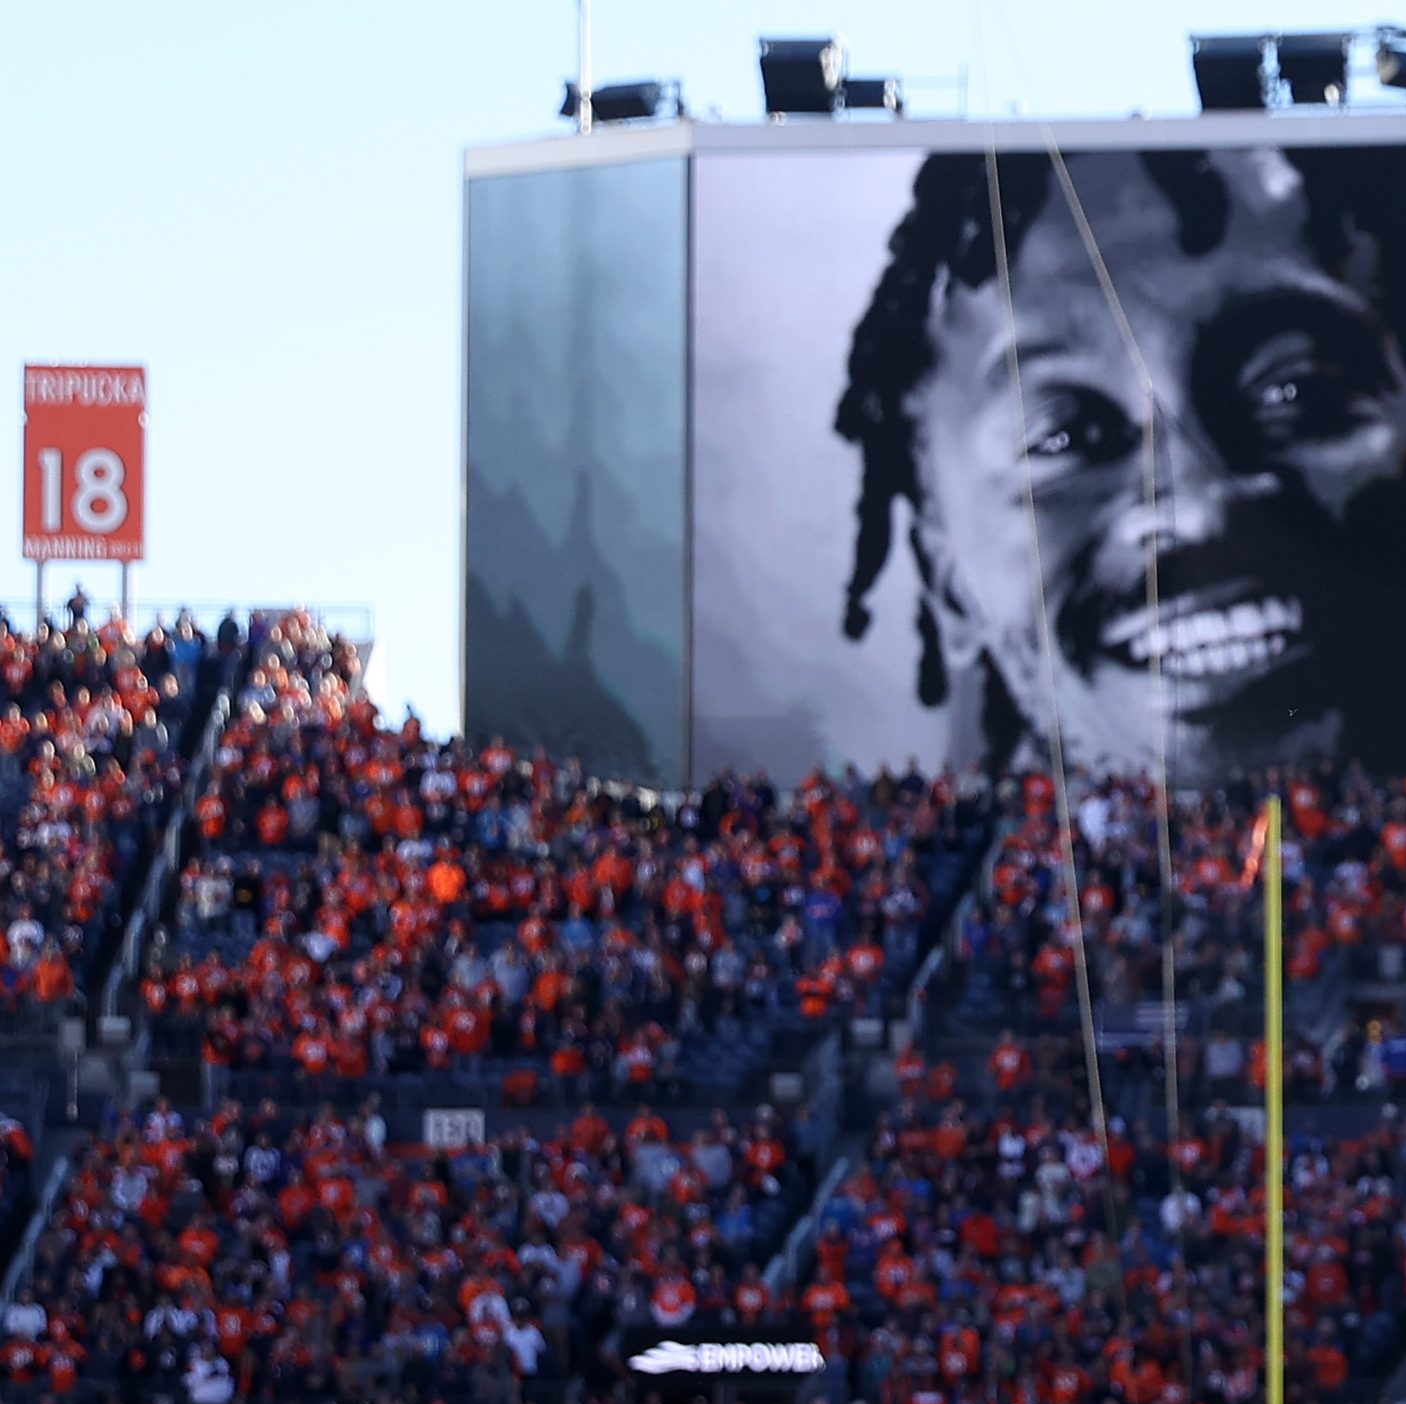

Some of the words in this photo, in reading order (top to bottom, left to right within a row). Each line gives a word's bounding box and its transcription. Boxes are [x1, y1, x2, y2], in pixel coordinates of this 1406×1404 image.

[25, 368, 145, 406] TRIPUCKA
[37, 447, 129, 535] 18
[24, 535, 108, 560] MANNING
